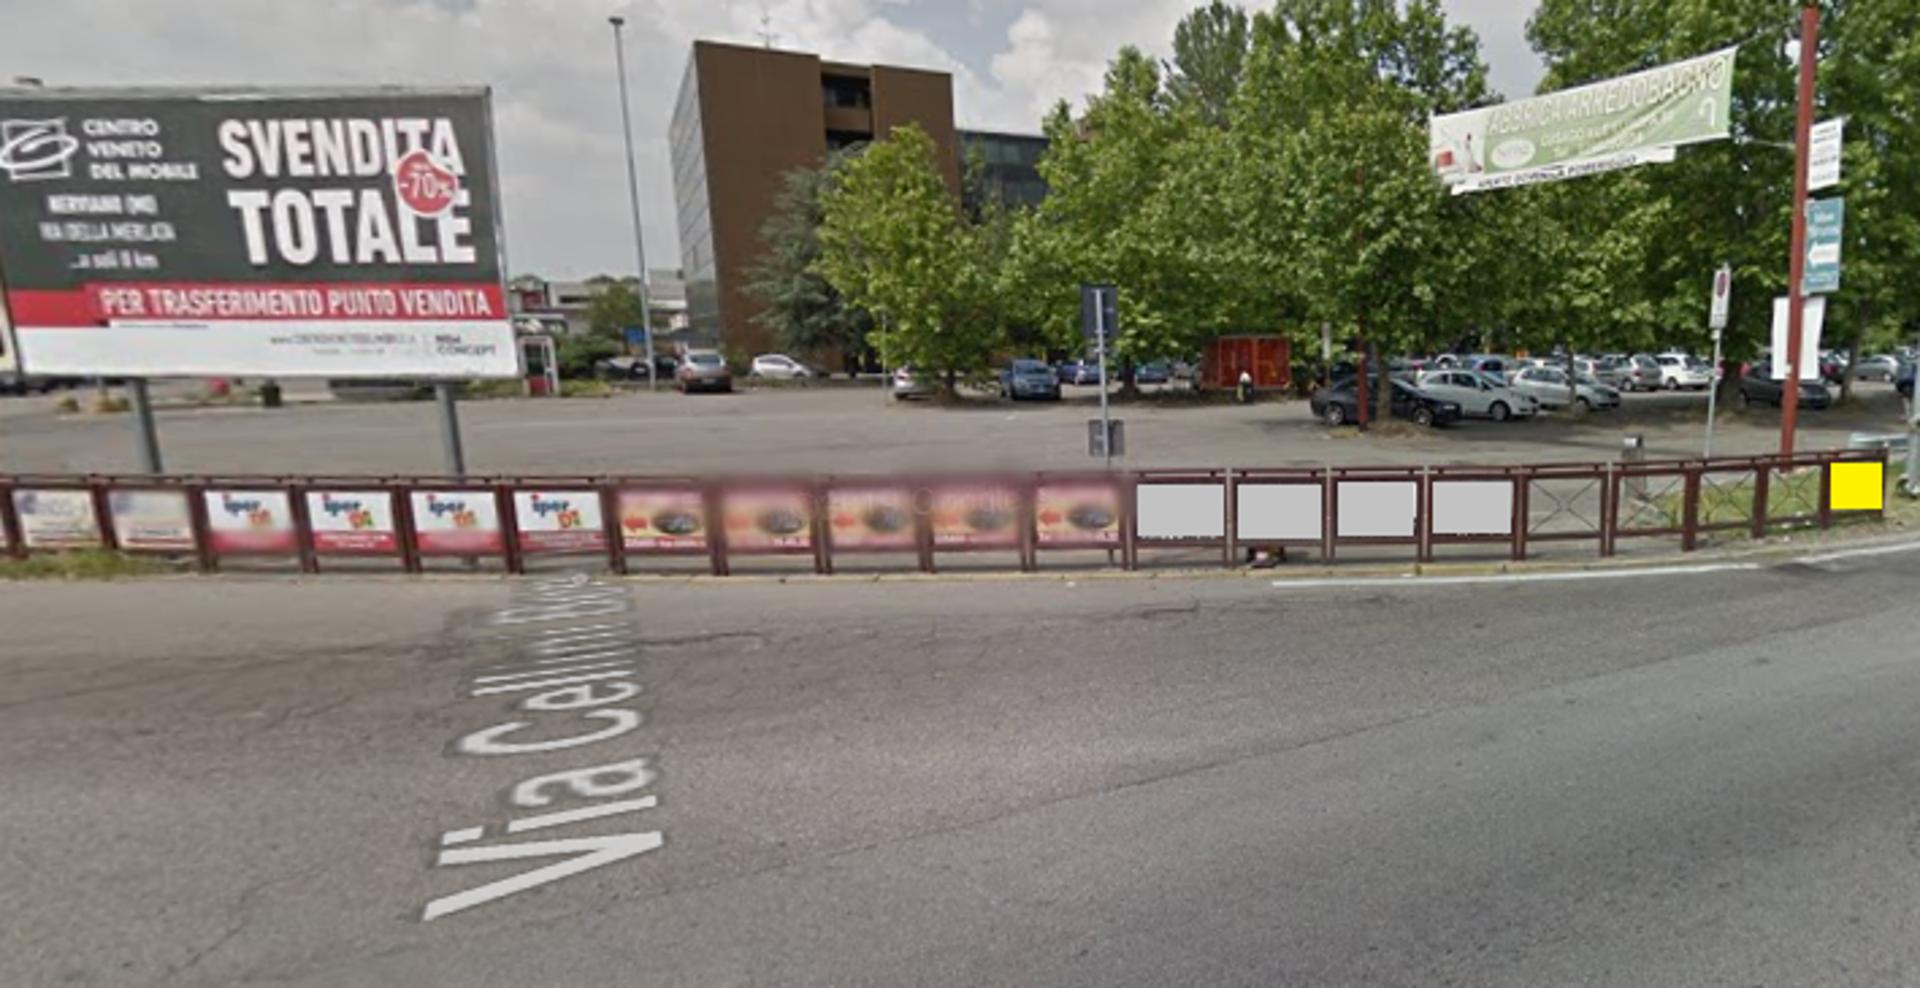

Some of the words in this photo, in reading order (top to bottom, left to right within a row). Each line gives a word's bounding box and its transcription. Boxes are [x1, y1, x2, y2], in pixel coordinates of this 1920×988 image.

[82, 118, 160, 136] CENTRO
[86, 140, 163, 158] VENETO
[218, 118, 465, 178] SVENDITA
[90, 162, 126, 180] DEL
[128, 162, 200, 180] MOBILE
[227, 188, 476, 264] TOTALE
[101, 288, 143, 316] PER
[146, 288, 323, 316] TRASFERIMENTO
[328, 288, 396, 316] PUNTO
[401, 288, 493, 316] VENDITA
